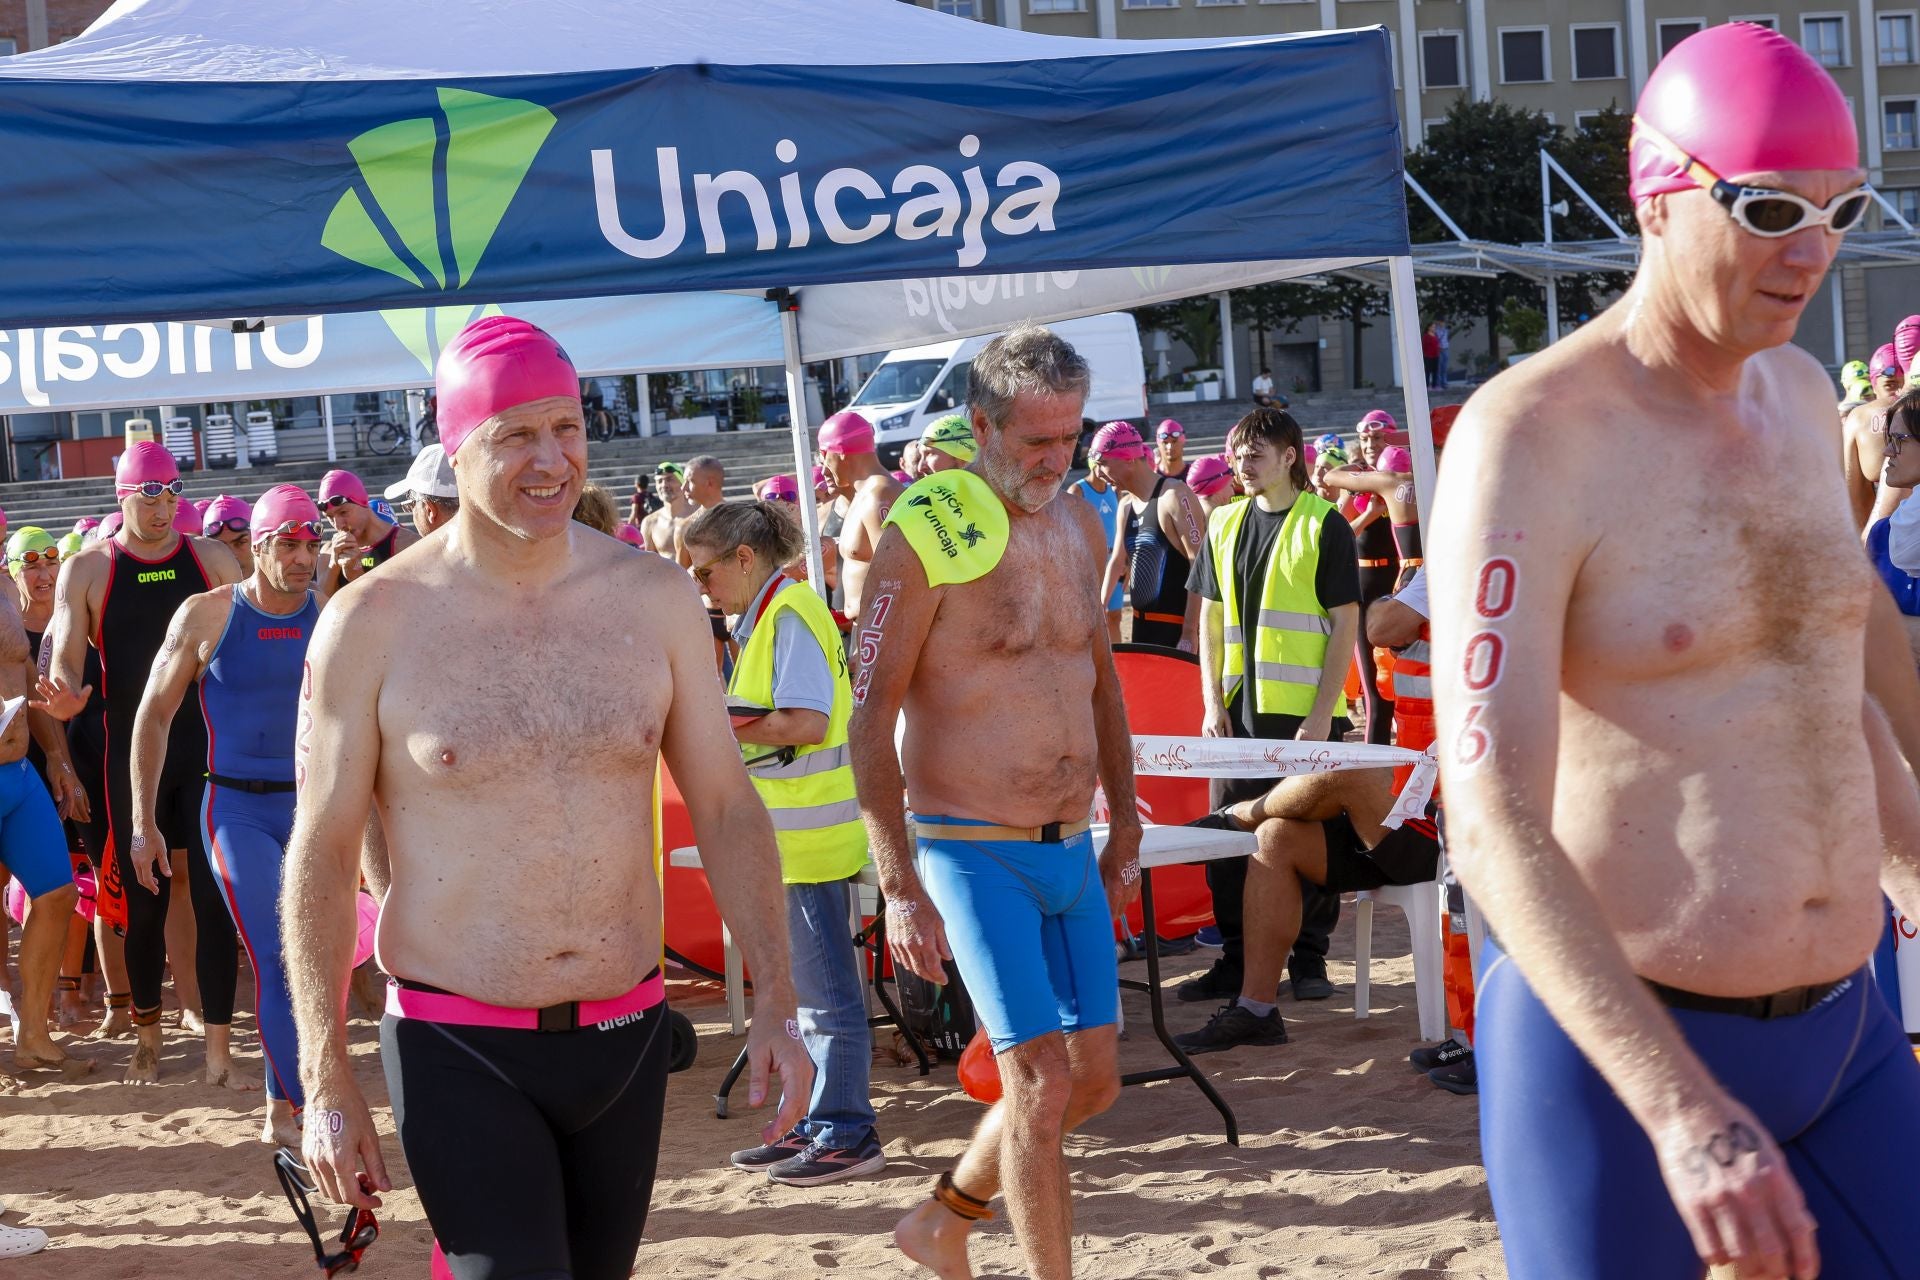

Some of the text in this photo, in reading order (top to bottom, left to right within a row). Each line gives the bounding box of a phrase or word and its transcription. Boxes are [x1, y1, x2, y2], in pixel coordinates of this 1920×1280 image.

[591, 134, 1060, 268] Unicaja
[1182, 496, 1200, 544] 113
[138, 569, 176, 583] arena
[257, 627, 303, 640] arena
[1457, 555, 1519, 766] 006
